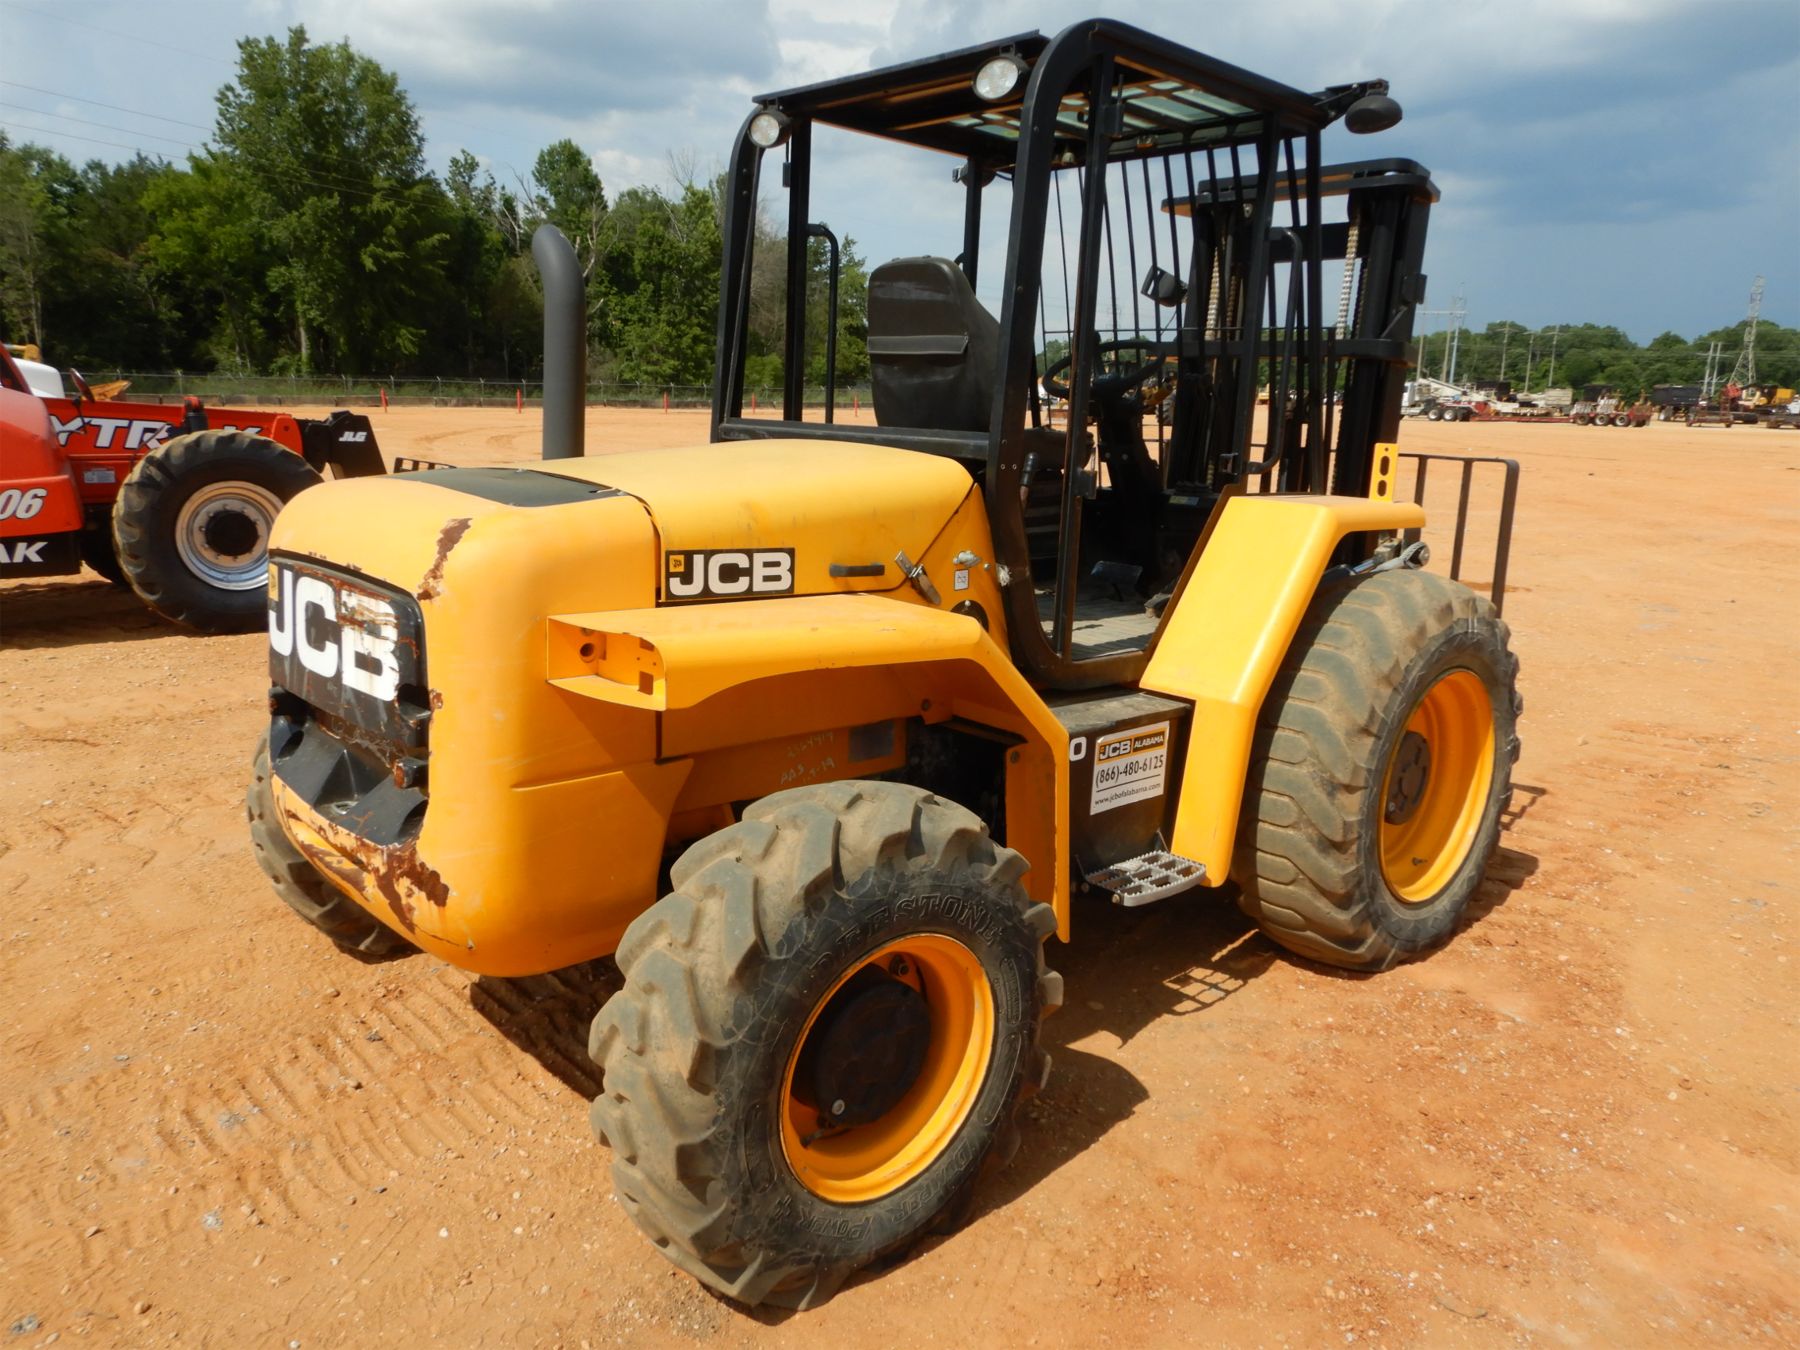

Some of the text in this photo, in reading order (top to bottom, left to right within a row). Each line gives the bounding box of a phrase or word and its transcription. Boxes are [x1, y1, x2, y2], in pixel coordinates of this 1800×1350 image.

[339, 431, 368, 442] JLG
[669, 552, 792, 596] JCB
[268, 568, 400, 702] JCB
[1099, 735, 1164, 760] JCB ALABAMA
[1095, 754, 1164, 789] (866)-480-6125
[1094, 782, 1161, 806] www.jcbofalabama.com
